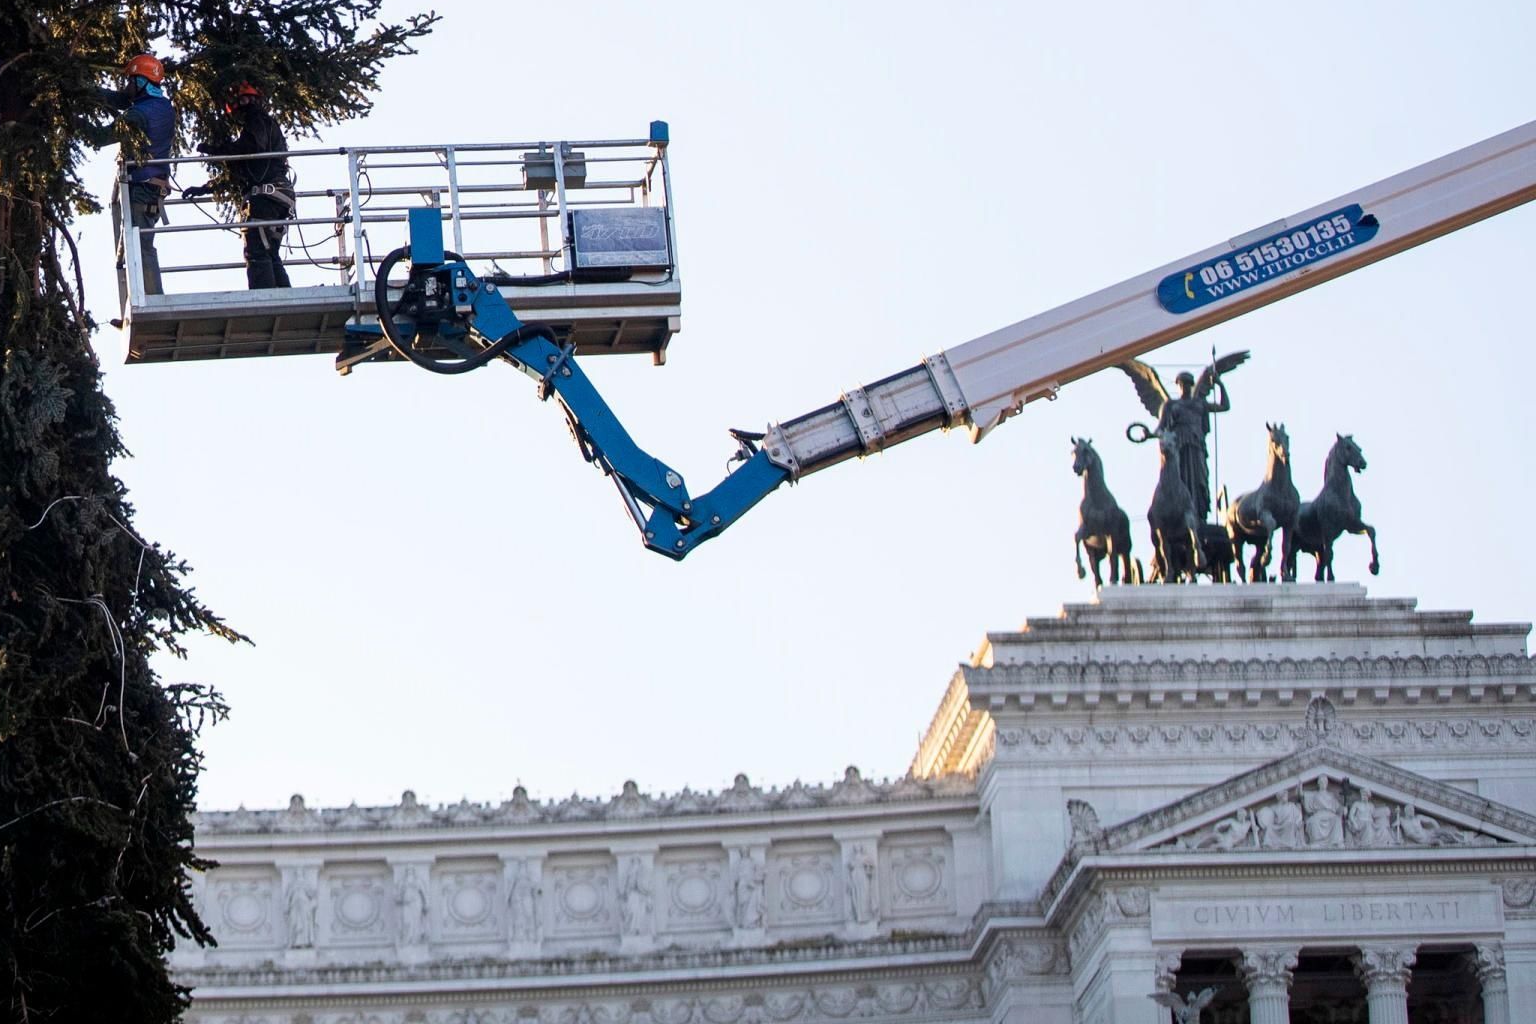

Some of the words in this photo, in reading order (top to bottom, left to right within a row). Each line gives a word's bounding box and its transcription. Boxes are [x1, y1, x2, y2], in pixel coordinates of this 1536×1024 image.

[1199, 260, 1234, 286] 06
[1238, 214, 1351, 270] 51530135
[1207, 232, 1355, 297] WWW.TITOCCI.IT
[1194, 905, 1295, 925] CIVIVM
[1323, 901, 1460, 922] LIBERTATI
